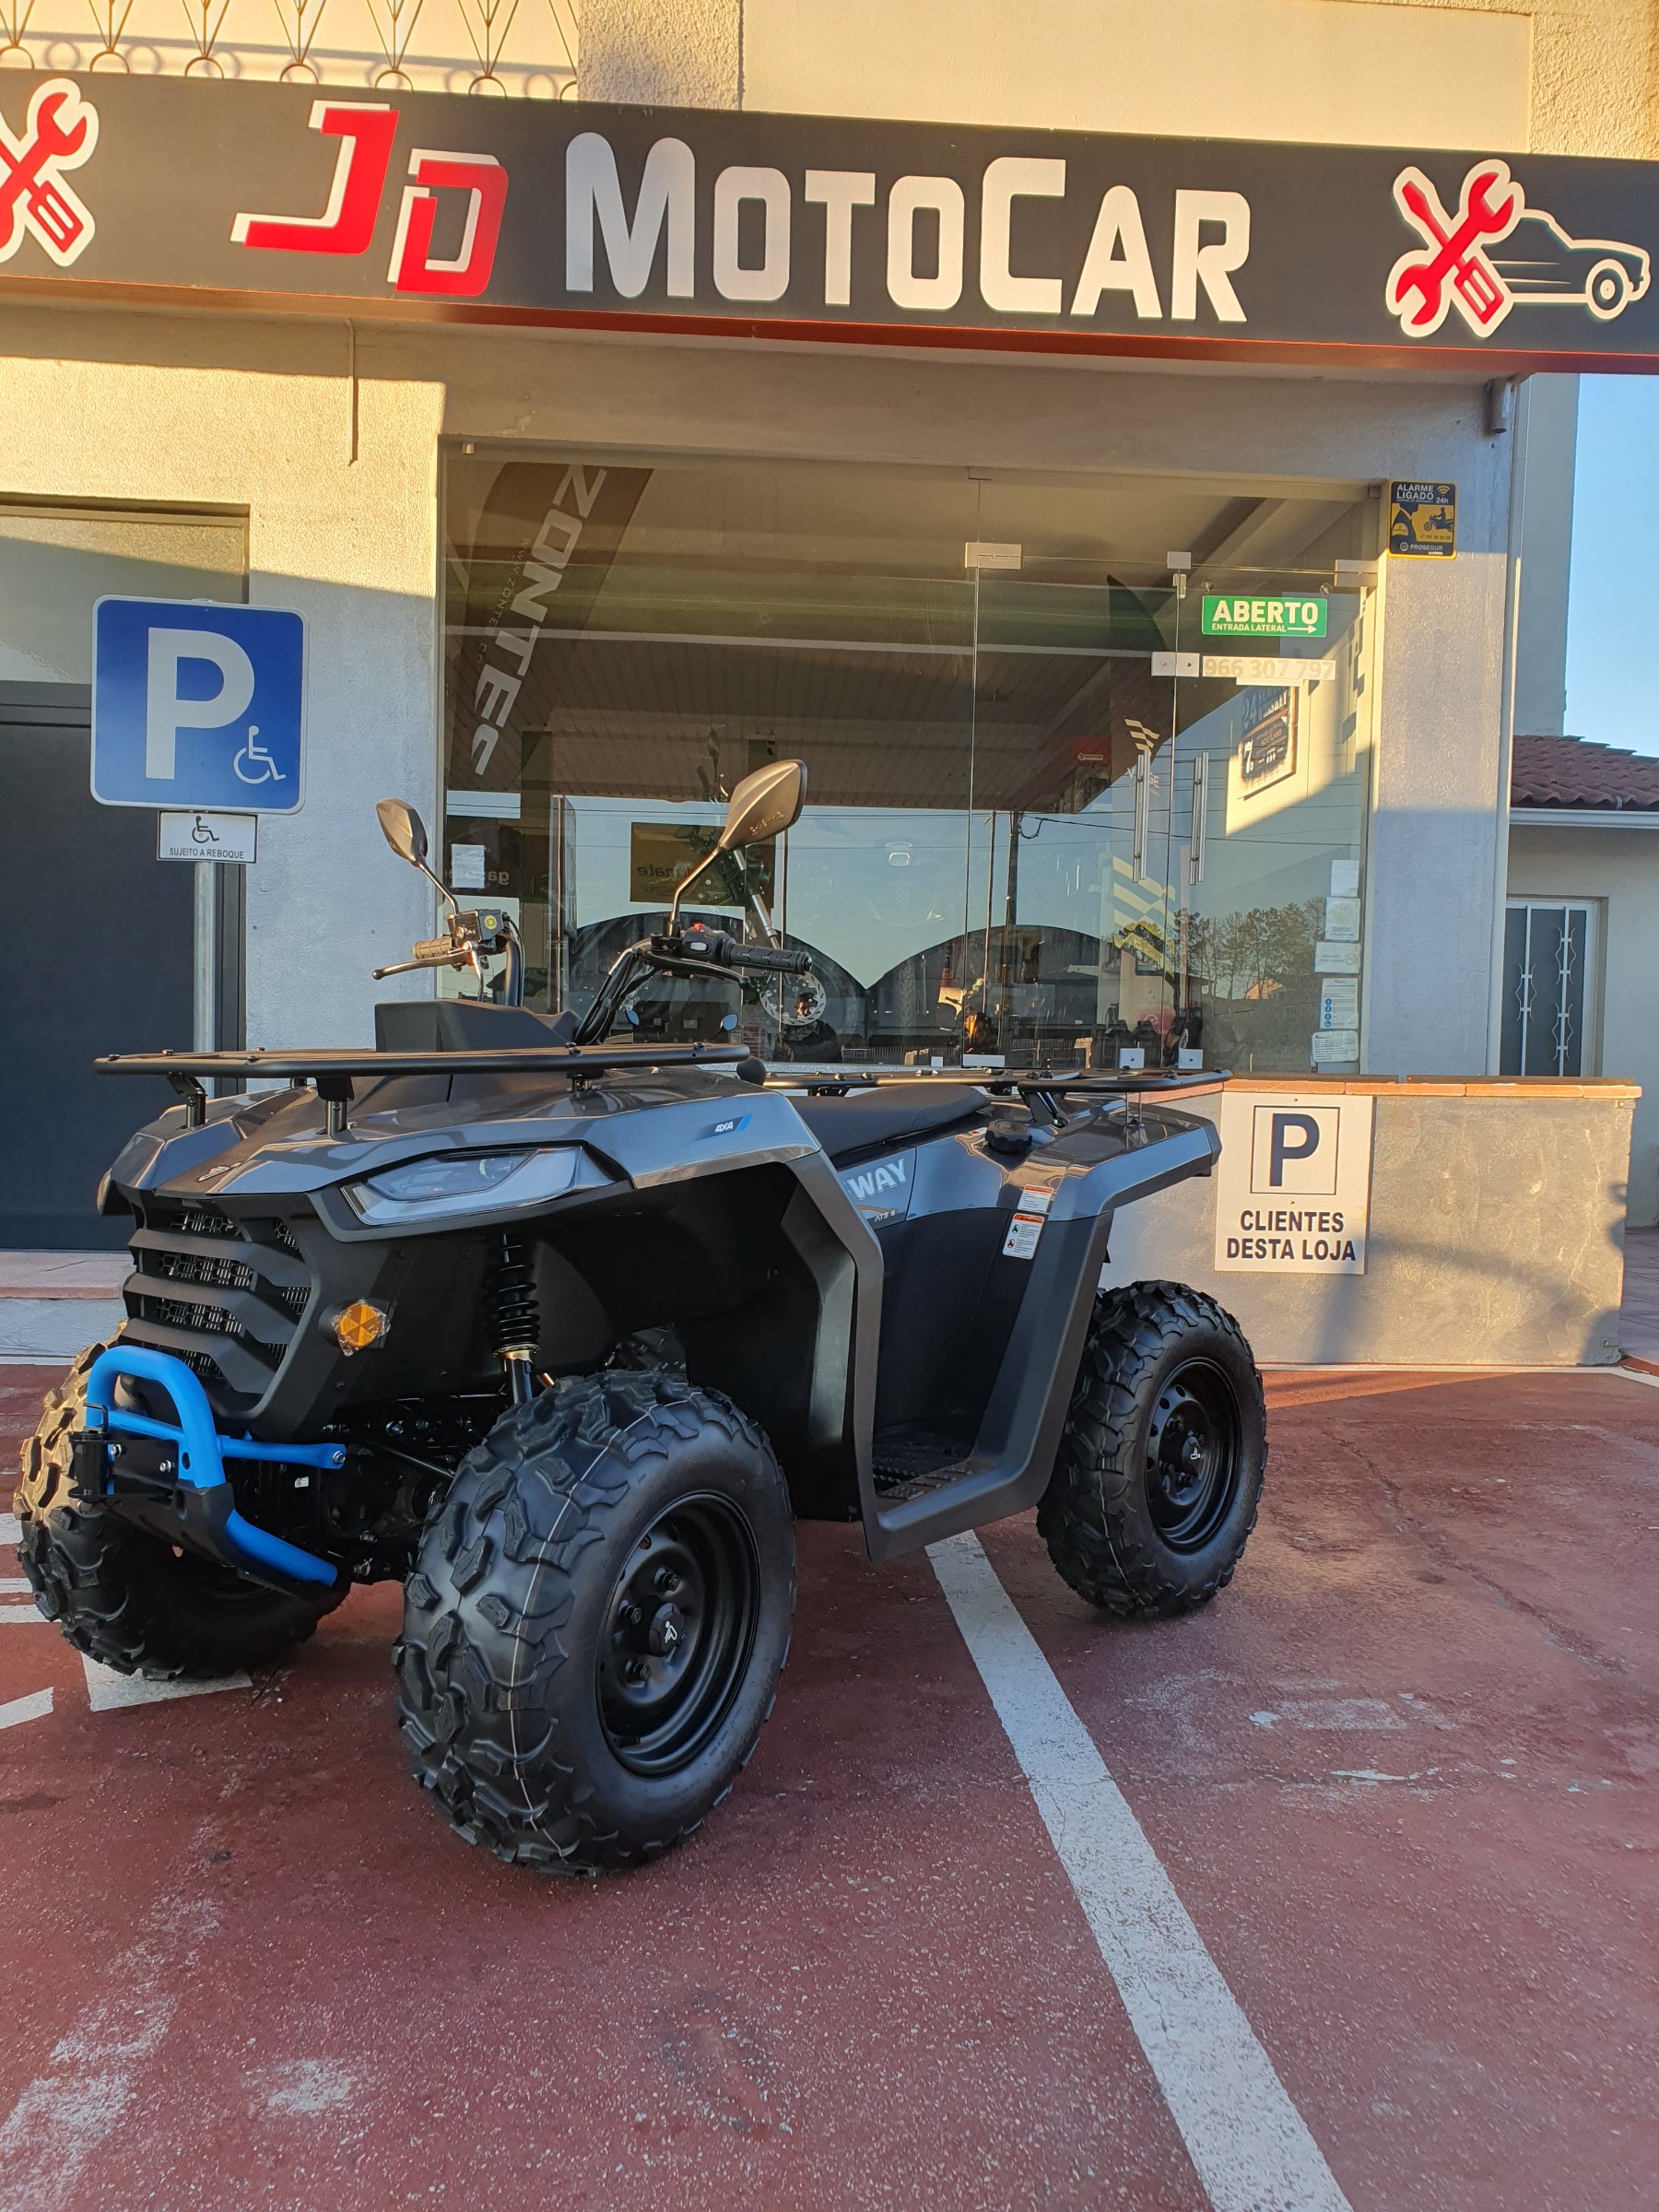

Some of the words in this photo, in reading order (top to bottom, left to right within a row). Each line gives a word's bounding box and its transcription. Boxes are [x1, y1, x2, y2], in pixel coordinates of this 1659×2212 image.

[1396, 484, 1434, 492] ALARME
[1396, 490, 1434, 500] LIGADO
[1212, 600, 1318, 625] ABERTO
[1212, 623, 1249, 631] ENTRADA
[1251, 624, 1287, 632] LATERAL
[1205, 658, 1243, 677] 966
[1250, 659, 1289, 677] 307
[1297, 660, 1335, 678] 797
[146, 627, 255, 780] P
[1127, 767, 1160, 789] VGE
[170, 847, 198, 856] SUJEITO
[200, 848, 206, 856] A
[206, 849, 244, 859] REBOQUE
[1269, 1113, 1320, 1187] P
[842, 1158, 908, 1201] WAY
[1240, 1210, 1345, 1233] CLIENTES
[1227, 1238, 1295, 1260] DESTA
[1302, 1240, 1357, 1261] LOJA
